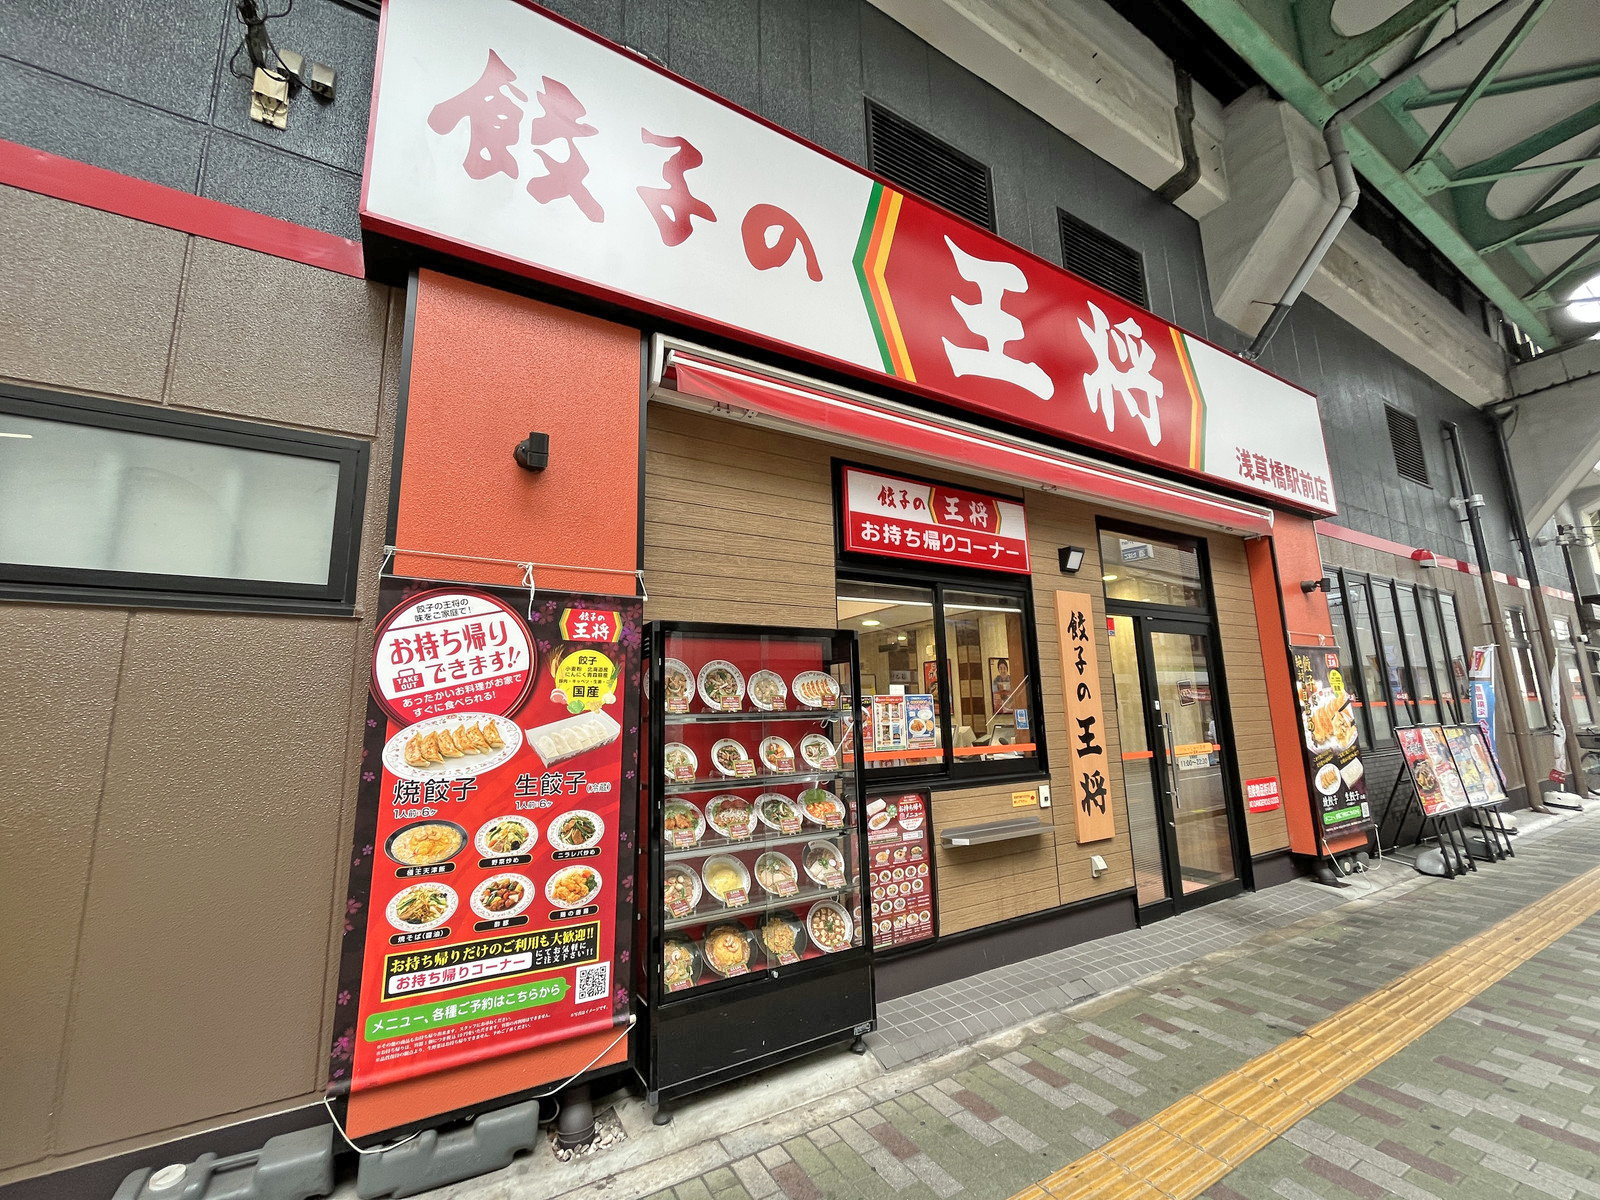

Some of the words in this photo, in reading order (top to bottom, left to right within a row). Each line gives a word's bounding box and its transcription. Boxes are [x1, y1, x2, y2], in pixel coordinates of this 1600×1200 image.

[1235, 446, 1329, 504] 浅草橋駅前店
[860, 520, 1020, 559] お持ち帰りコーナー
[416, 598, 470, 614] 餃子の王将の
[389, 620, 508, 666] お持ち帰り
[572, 621, 610, 641] 王将
[578, 655, 598, 666] 餃子
[395, 675, 420, 686] TAKE
[400, 682, 418, 692] OUT
[402, 674, 522, 708] あったかいお料理がお家で
[572, 685, 600, 698] 国産
[1066, 610, 1108, 816] 餃子の王将
[393, 777, 478, 806] 焼餃子
[514, 771, 587, 797] 生餃子
[490, 856, 520, 866] 野菜炒め
[535, 942, 587, 958] にてお気軽に
[395, 957, 526, 990] お持ち帰りコーナー
[371, 984, 561, 1034] メニュー、各種ご予約はこちらから
